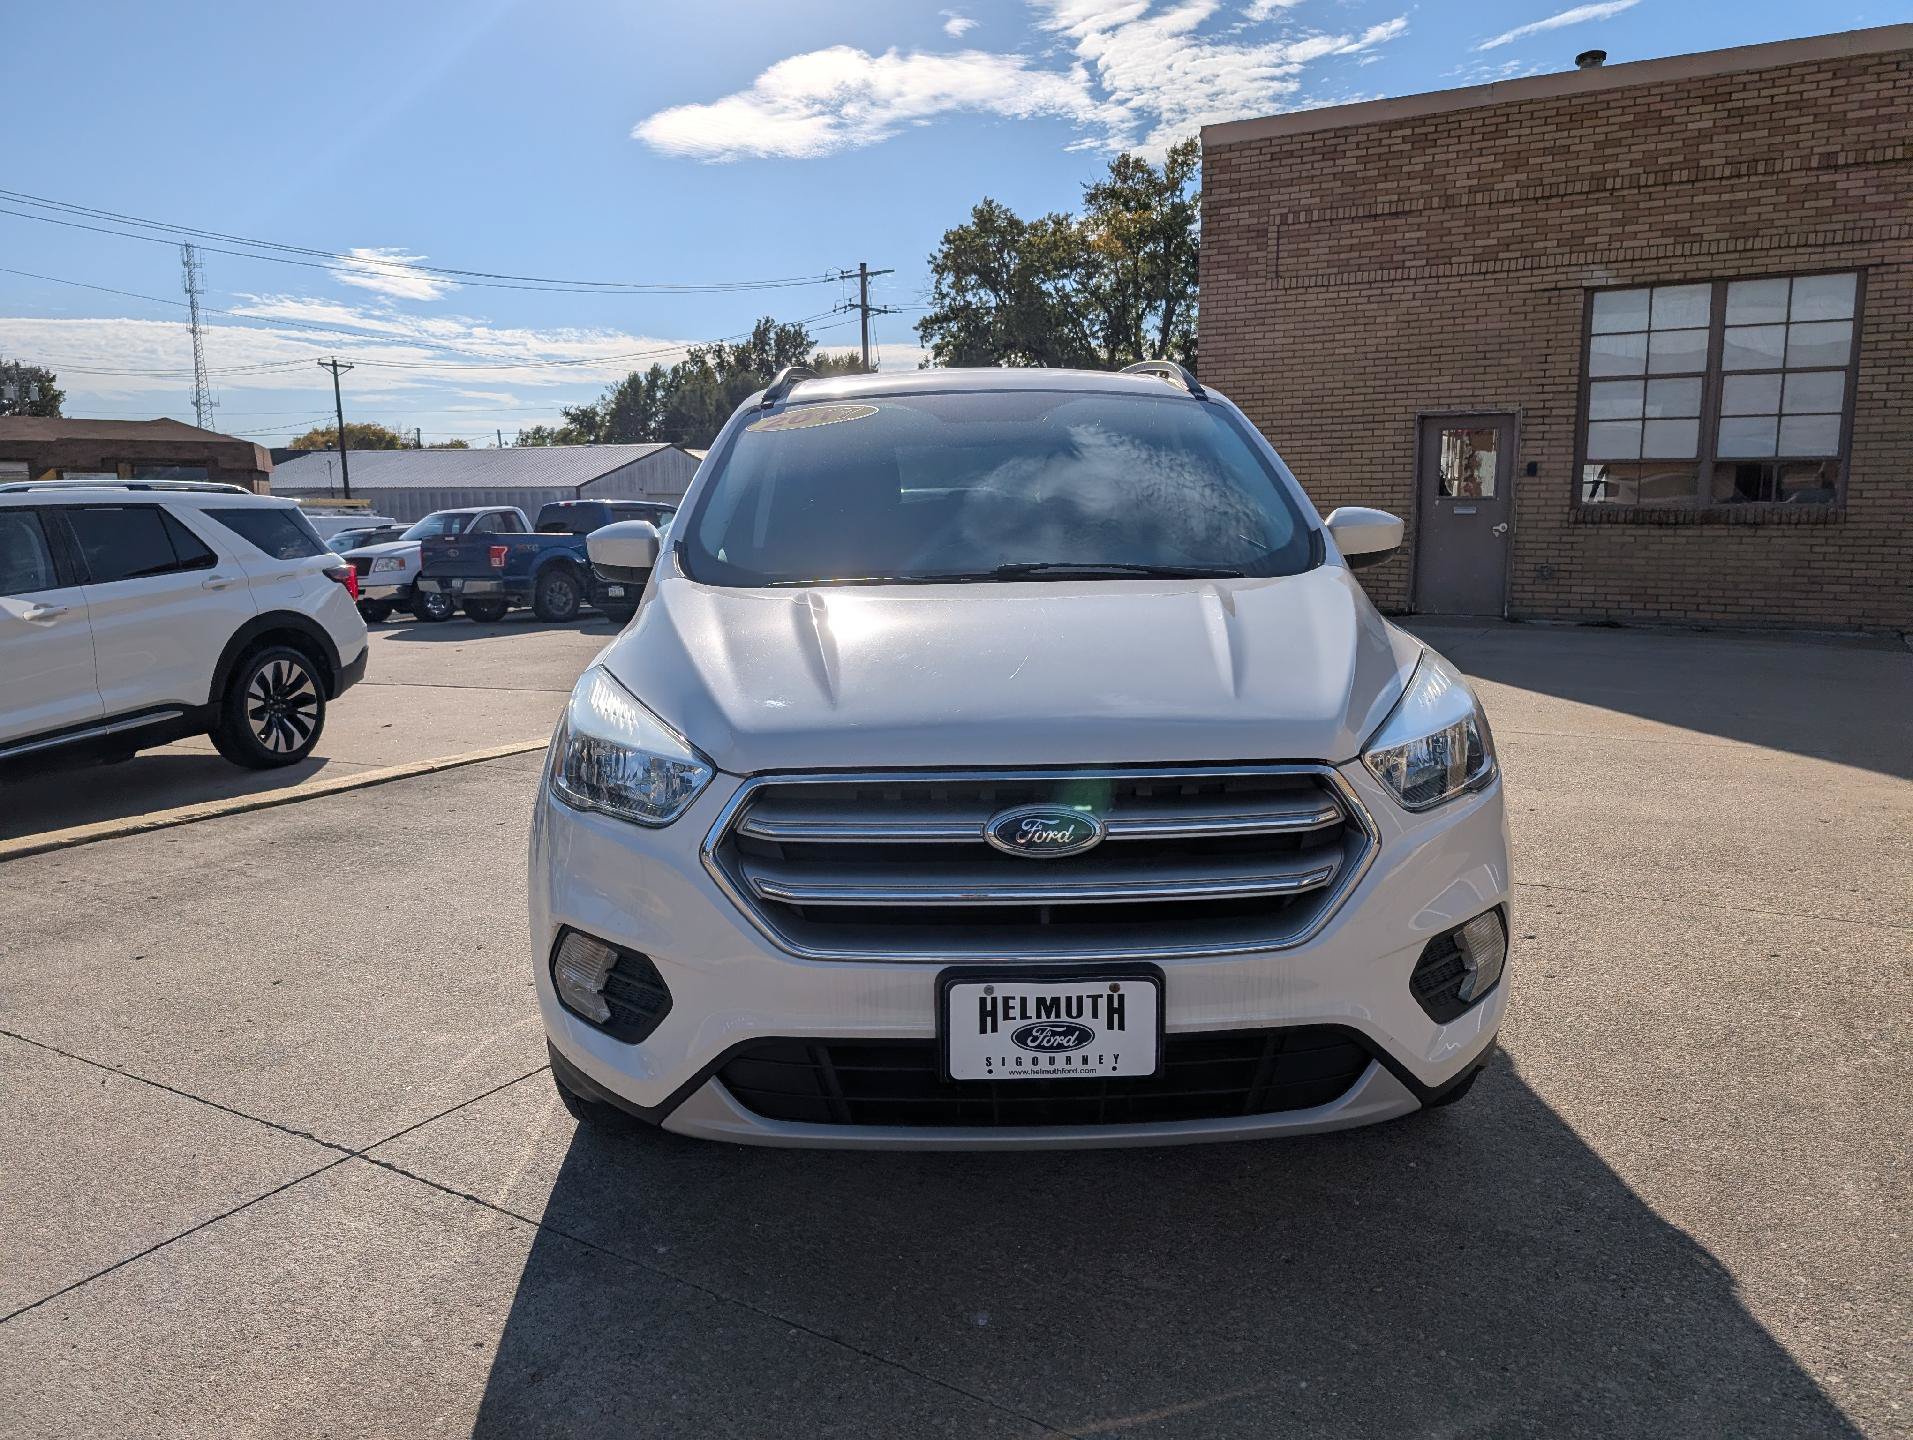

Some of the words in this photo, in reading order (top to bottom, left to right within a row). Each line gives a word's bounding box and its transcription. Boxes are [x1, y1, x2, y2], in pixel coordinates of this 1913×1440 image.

[1016, 818, 1075, 843] Ford
[978, 993, 1126, 1035] HELMUTH
[1027, 1026, 1079, 1047] Ford
[985, 1053, 1120, 1067] SIGOURNEY
[1008, 1067, 1097, 1076] www.helmuthford.com
